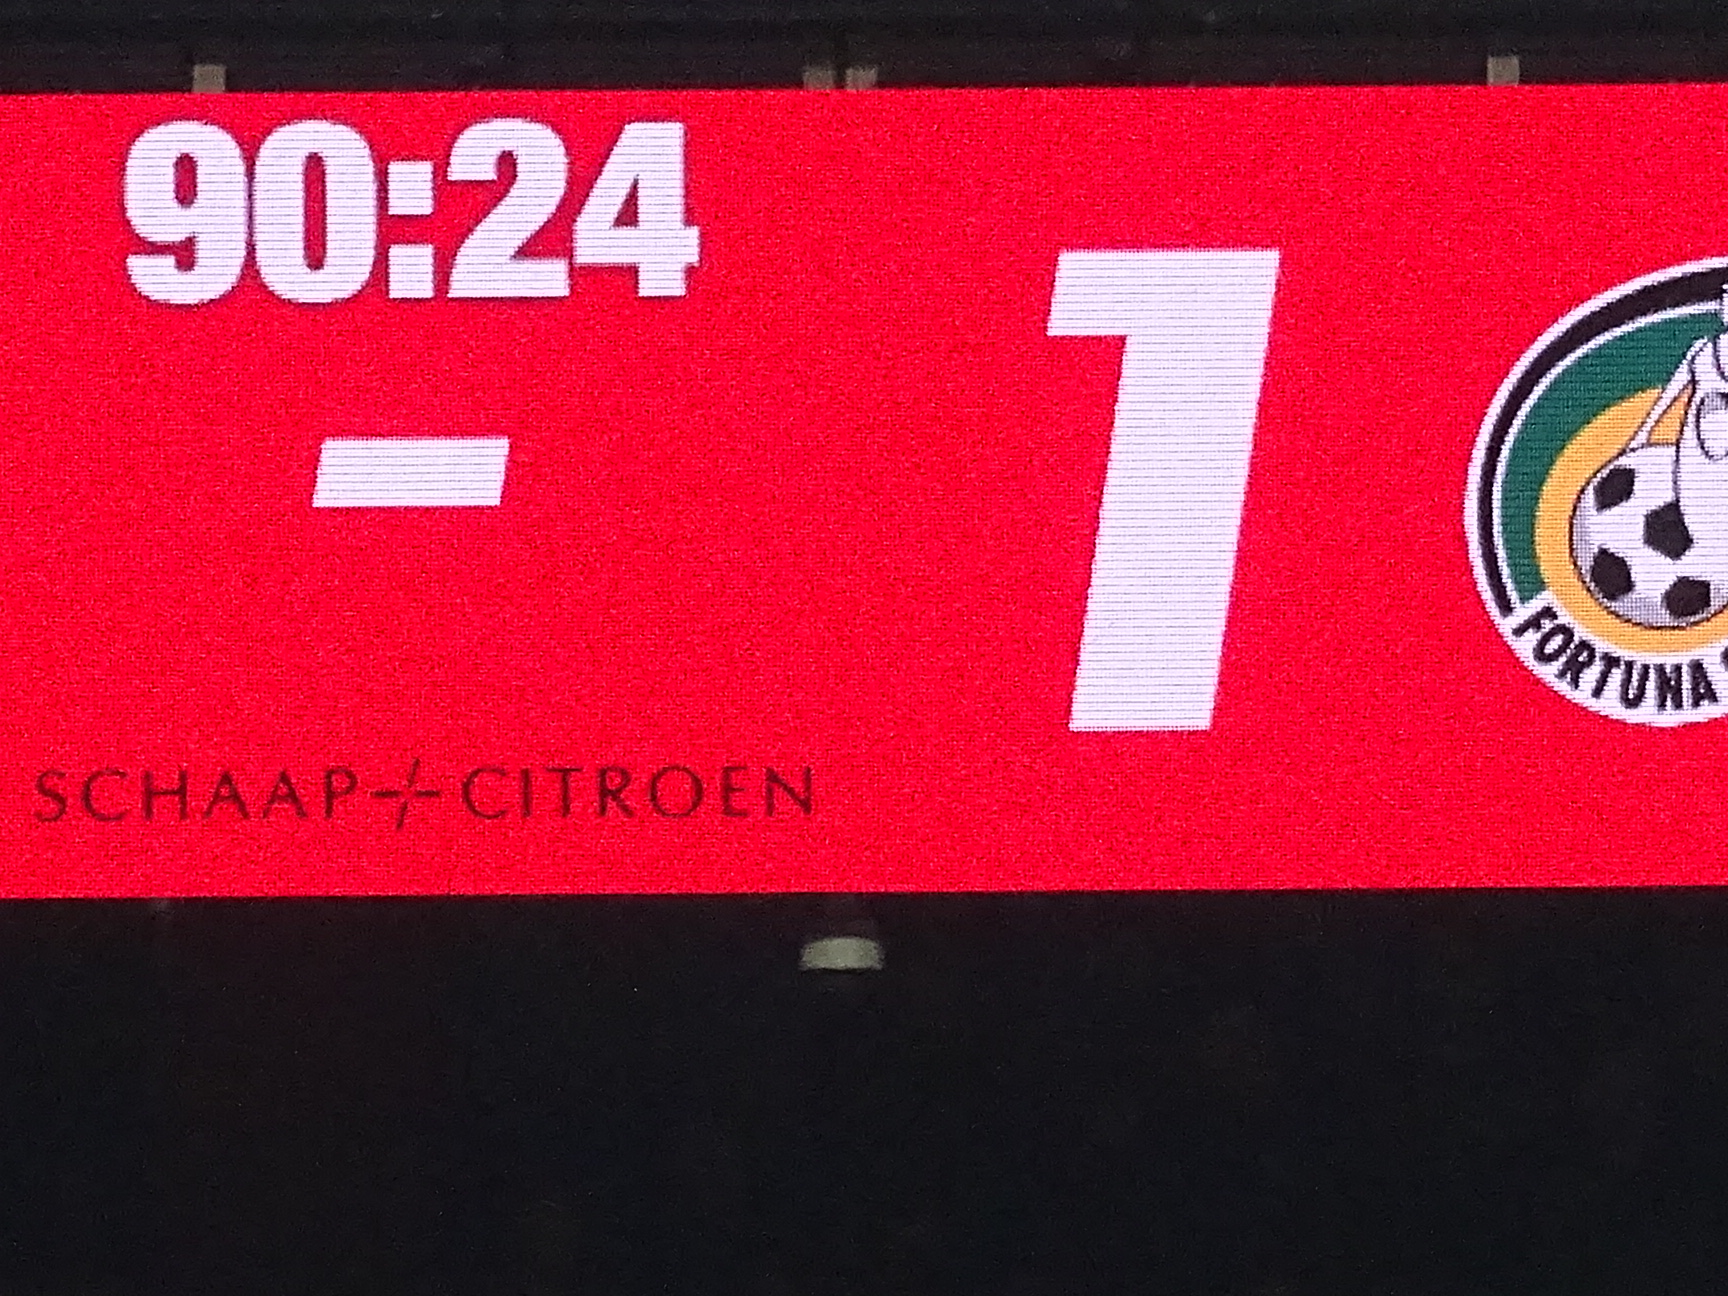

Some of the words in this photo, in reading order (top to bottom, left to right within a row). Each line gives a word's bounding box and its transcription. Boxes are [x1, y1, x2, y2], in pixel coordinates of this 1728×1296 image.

[122, 118, 701, 306] 90:24
[1044, 248, 1282, 733] 1
[1512, 605, 1719, 712] FORTUNA
[460, 762, 818, 821] CITROEN
